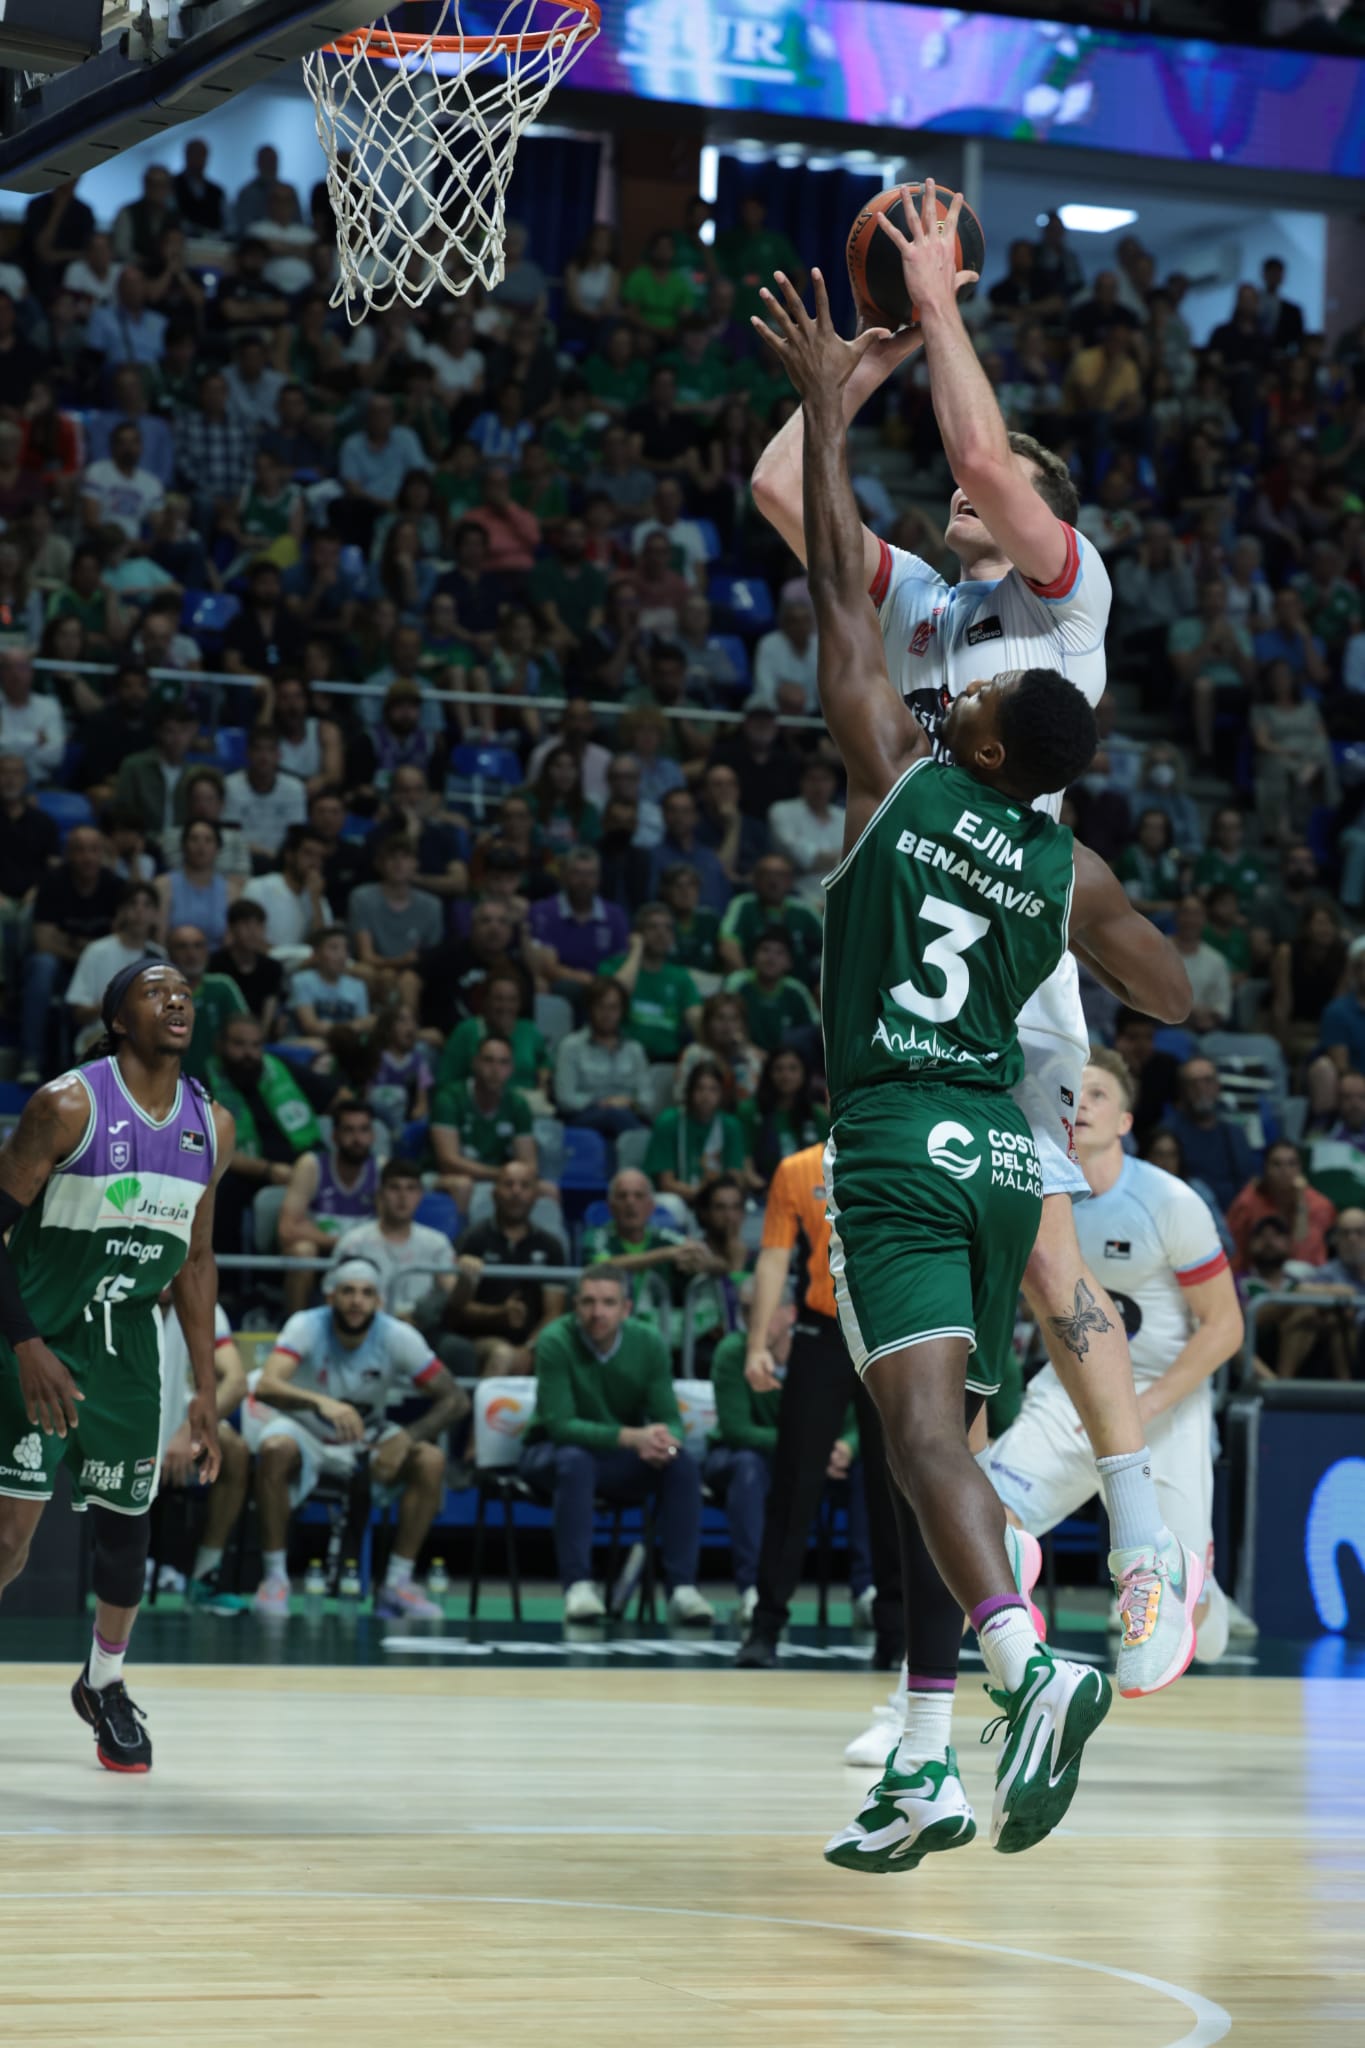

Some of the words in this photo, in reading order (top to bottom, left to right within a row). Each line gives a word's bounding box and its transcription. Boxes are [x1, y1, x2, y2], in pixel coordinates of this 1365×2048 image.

[952, 809, 1023, 871] EJIM
[896, 829, 1045, 917] BENAHAVÍS
[889, 894, 991, 1023] 3
[991, 1150, 1023, 1171] DEL
[1026, 1157, 1042, 1179] SO
[105, 1235, 163, 1264] mlaga
